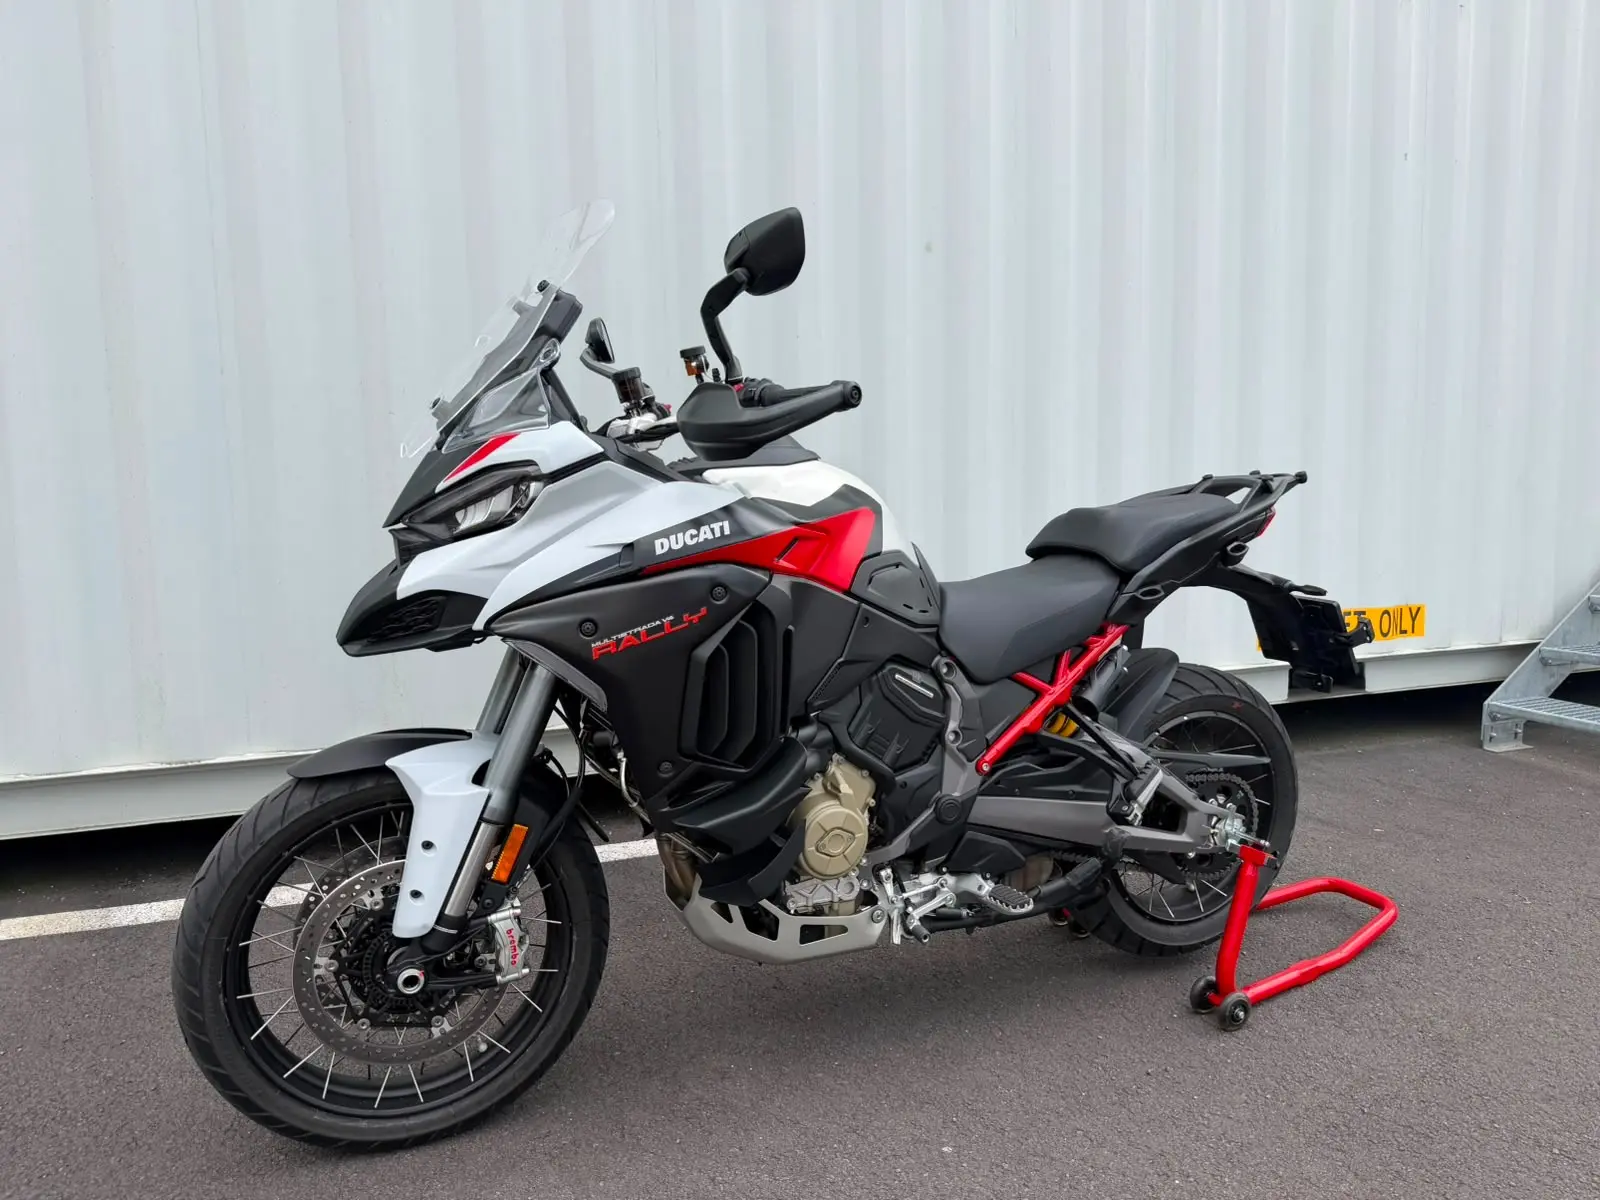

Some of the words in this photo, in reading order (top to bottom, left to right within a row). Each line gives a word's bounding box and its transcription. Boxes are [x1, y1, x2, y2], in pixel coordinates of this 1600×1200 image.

[654, 520, 731, 556] DUCATI
[591, 620, 662, 648] MULTISTRADA
[592, 607, 708, 660] RALLY
[1379, 606, 1421, 638] ONLY
[506, 928, 520, 966] brembo
